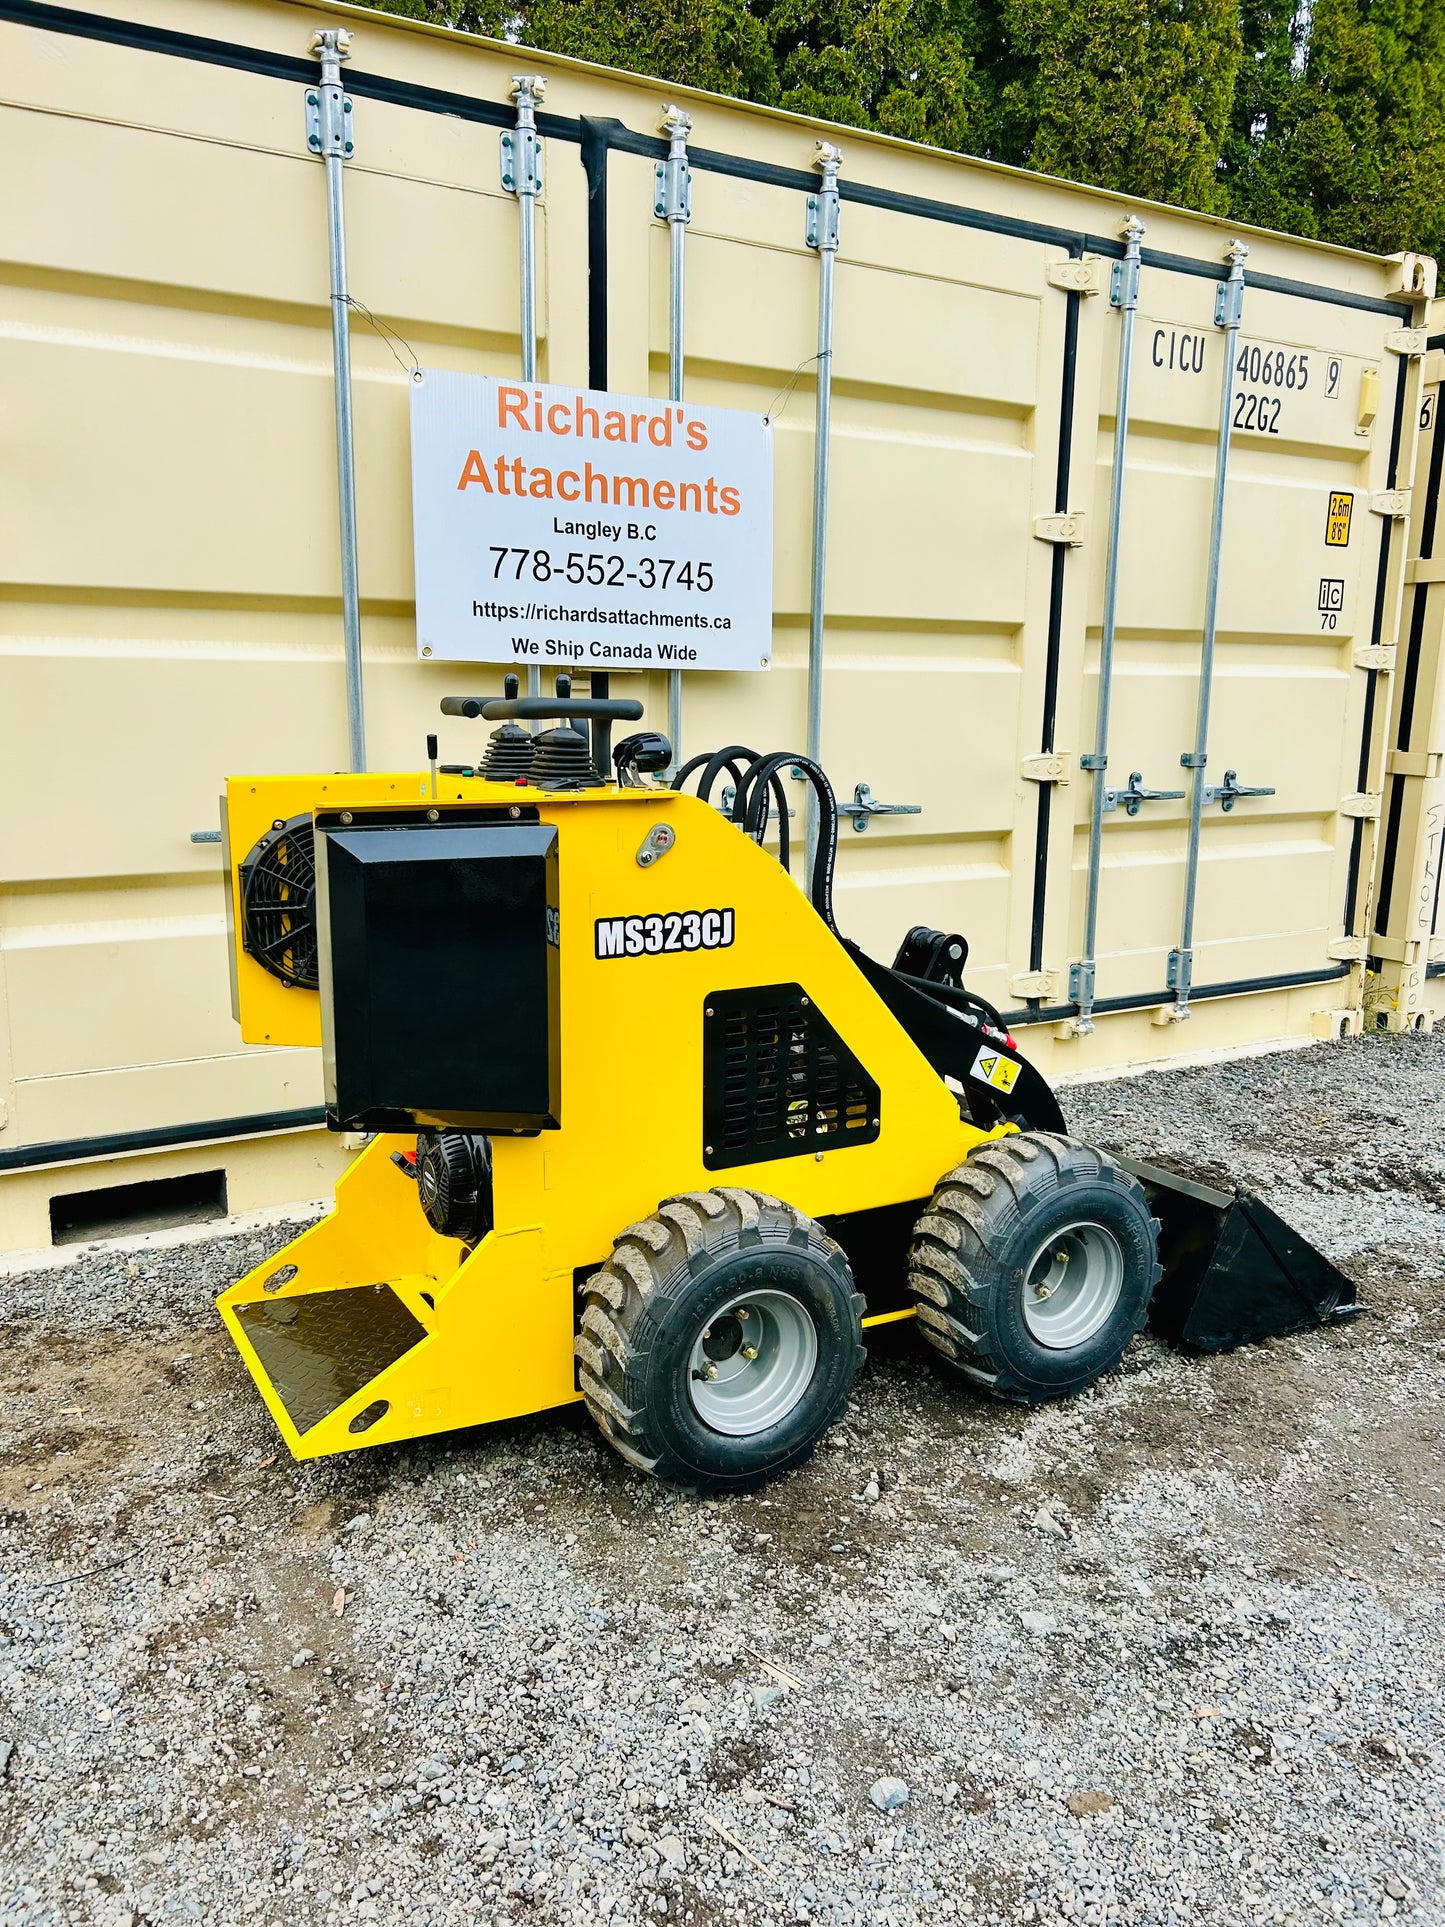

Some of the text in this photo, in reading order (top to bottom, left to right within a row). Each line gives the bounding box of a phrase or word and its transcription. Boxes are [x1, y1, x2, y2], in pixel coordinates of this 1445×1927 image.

[1152, 329, 1339, 394] CICU 406865 9
[497, 385, 709, 451] Richard's
[1233, 392, 1281, 434] 22G2
[1419, 397, 1432, 429] 6
[457, 449, 741, 516] Attachments
[553, 517, 657, 541] Langley B.C
[489, 546, 714, 593] 778-552-3745
[472, 600, 731, 630] https://richardsattachments.ca
[1321, 612, 1338, 630] 70
[511, 637, 697, 661] We Ship Canada Wide
[598, 911, 735, 956] MS323CJ
